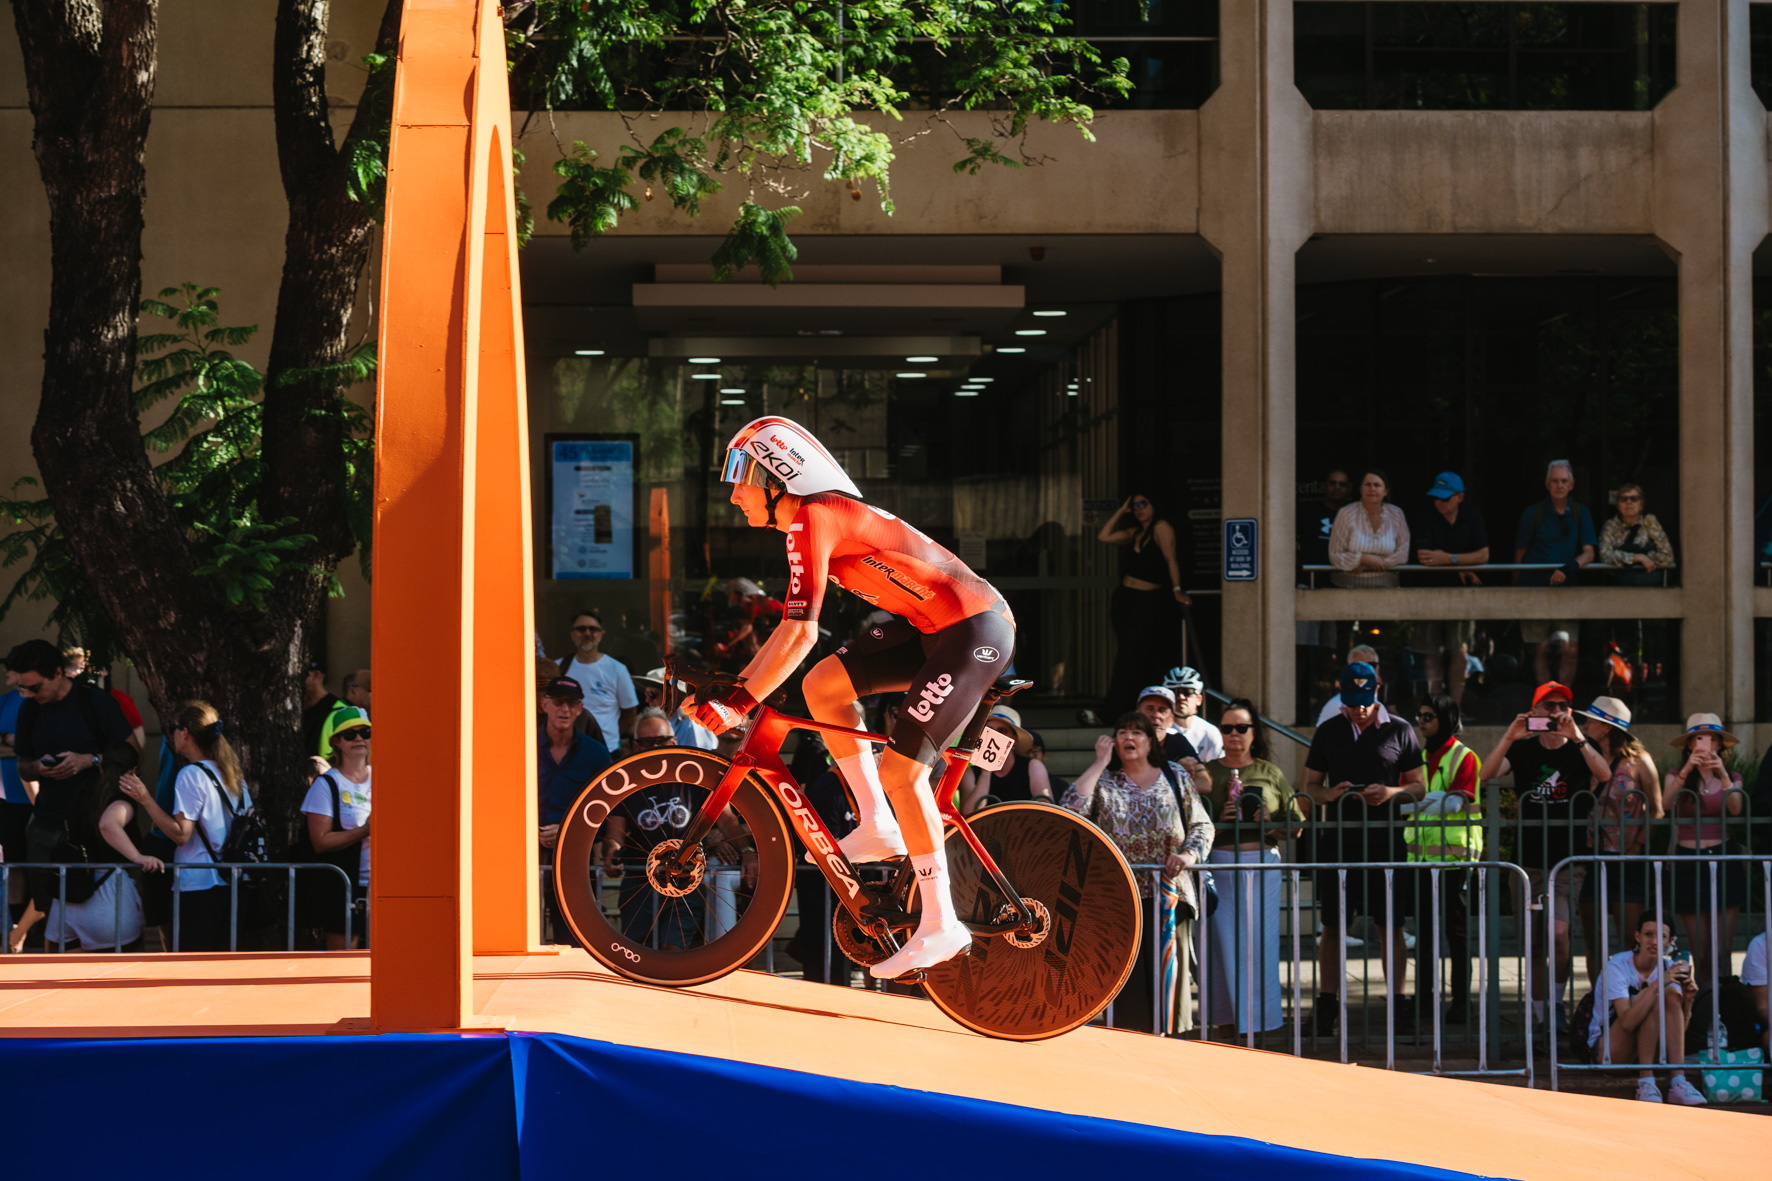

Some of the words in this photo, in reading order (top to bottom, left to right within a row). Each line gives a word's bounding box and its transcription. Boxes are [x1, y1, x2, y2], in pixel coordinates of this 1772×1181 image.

[982, 737, 1001, 763] 87
[583, 758, 704, 829] OQUO
[778, 781, 860, 900] ORBEA
